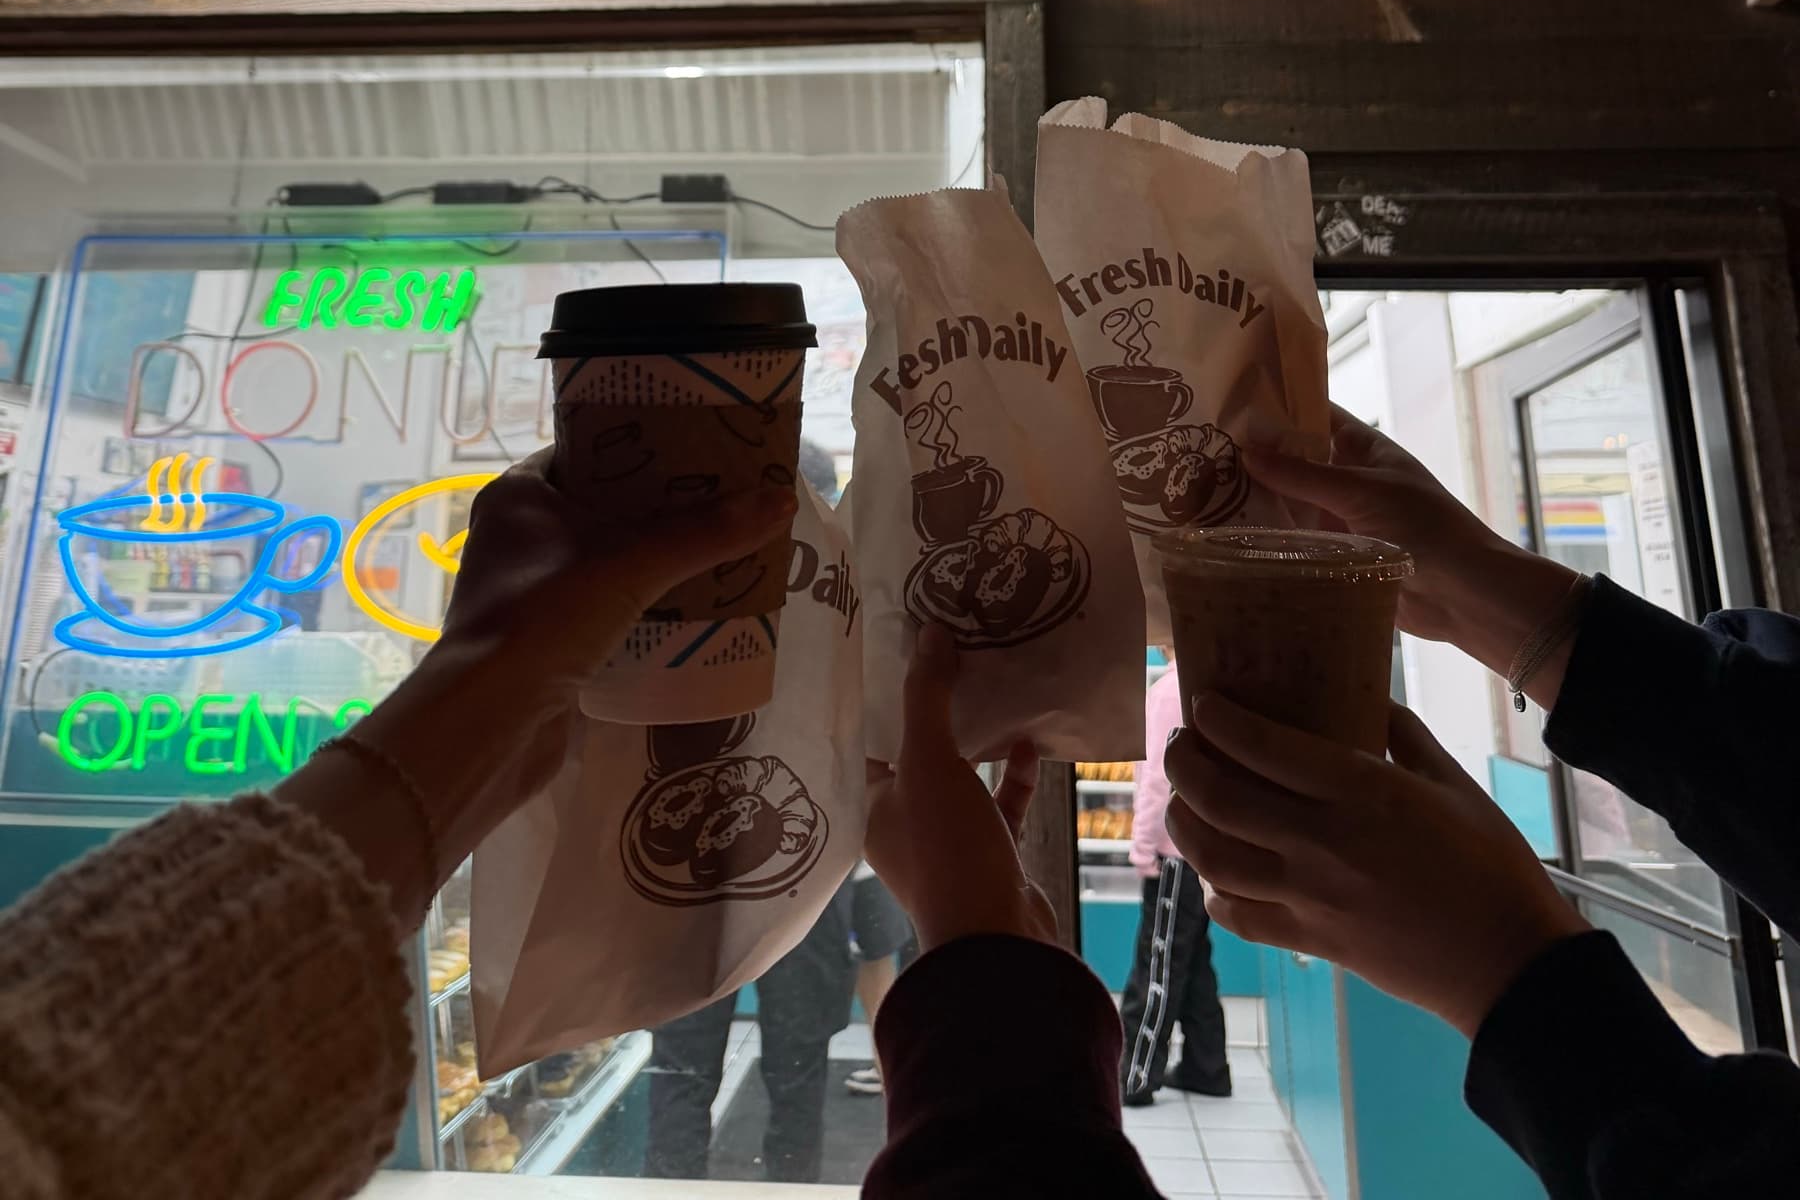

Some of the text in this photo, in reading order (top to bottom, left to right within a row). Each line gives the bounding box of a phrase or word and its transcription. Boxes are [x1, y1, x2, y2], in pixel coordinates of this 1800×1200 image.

[263, 266, 477, 331] FRESH
[1055, 247, 1265, 329] Fresh Daily
[869, 317, 968, 417] Fesh
[786, 538, 860, 639] Daily
[57, 690, 303, 774] OPEN
